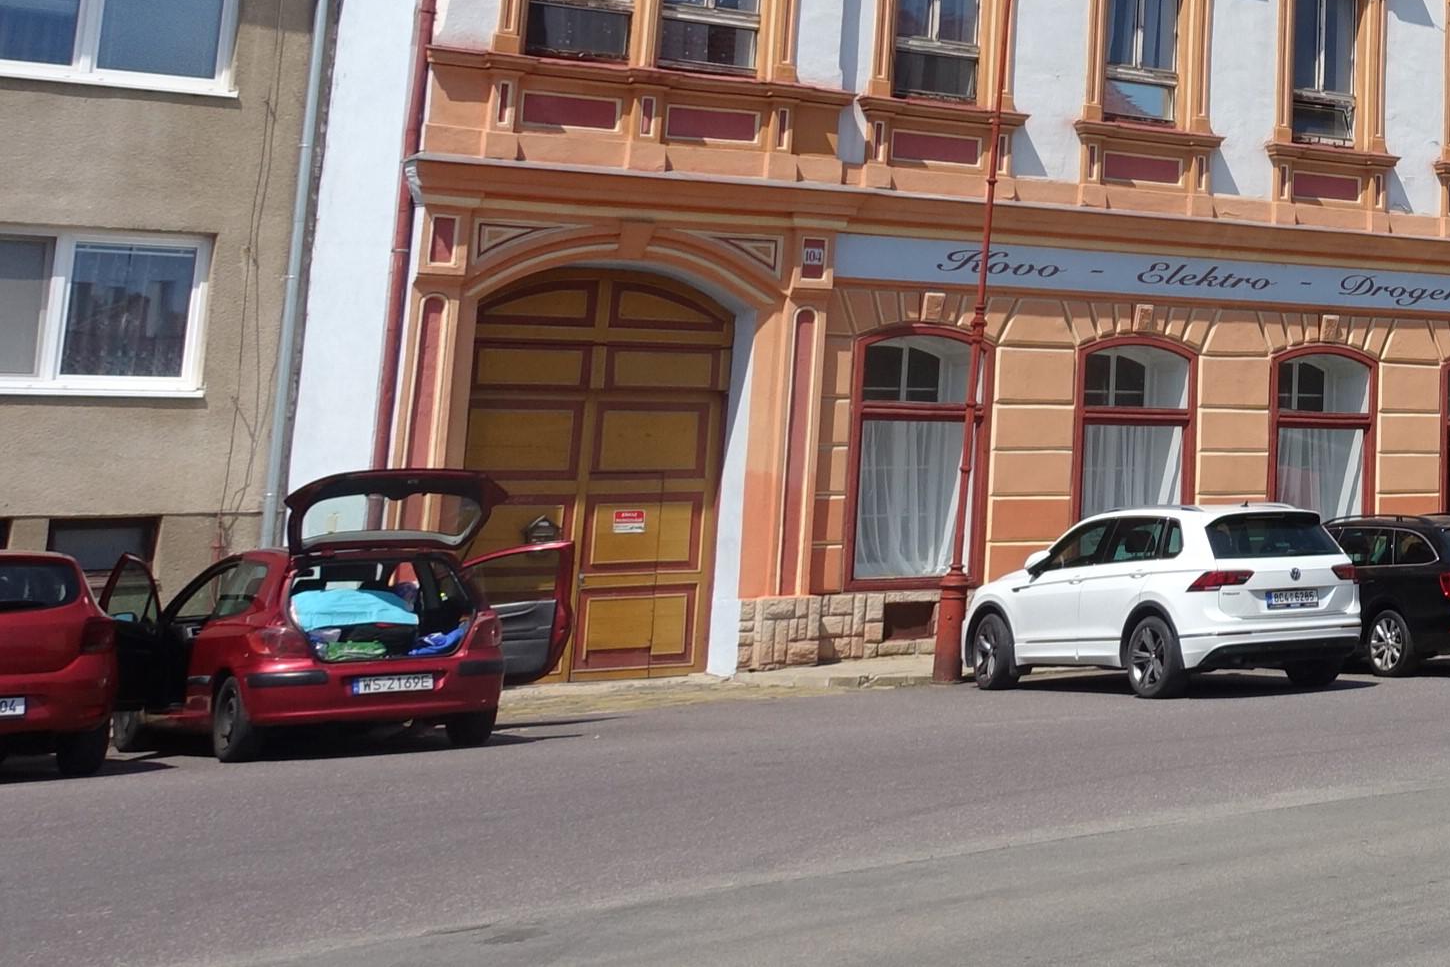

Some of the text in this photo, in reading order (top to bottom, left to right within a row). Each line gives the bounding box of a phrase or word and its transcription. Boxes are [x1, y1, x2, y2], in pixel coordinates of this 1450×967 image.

[805, 250, 822, 263] 104
[937, 249, 1067, 278] Kovo
[1137, 262, 1277, 290] Elektro
